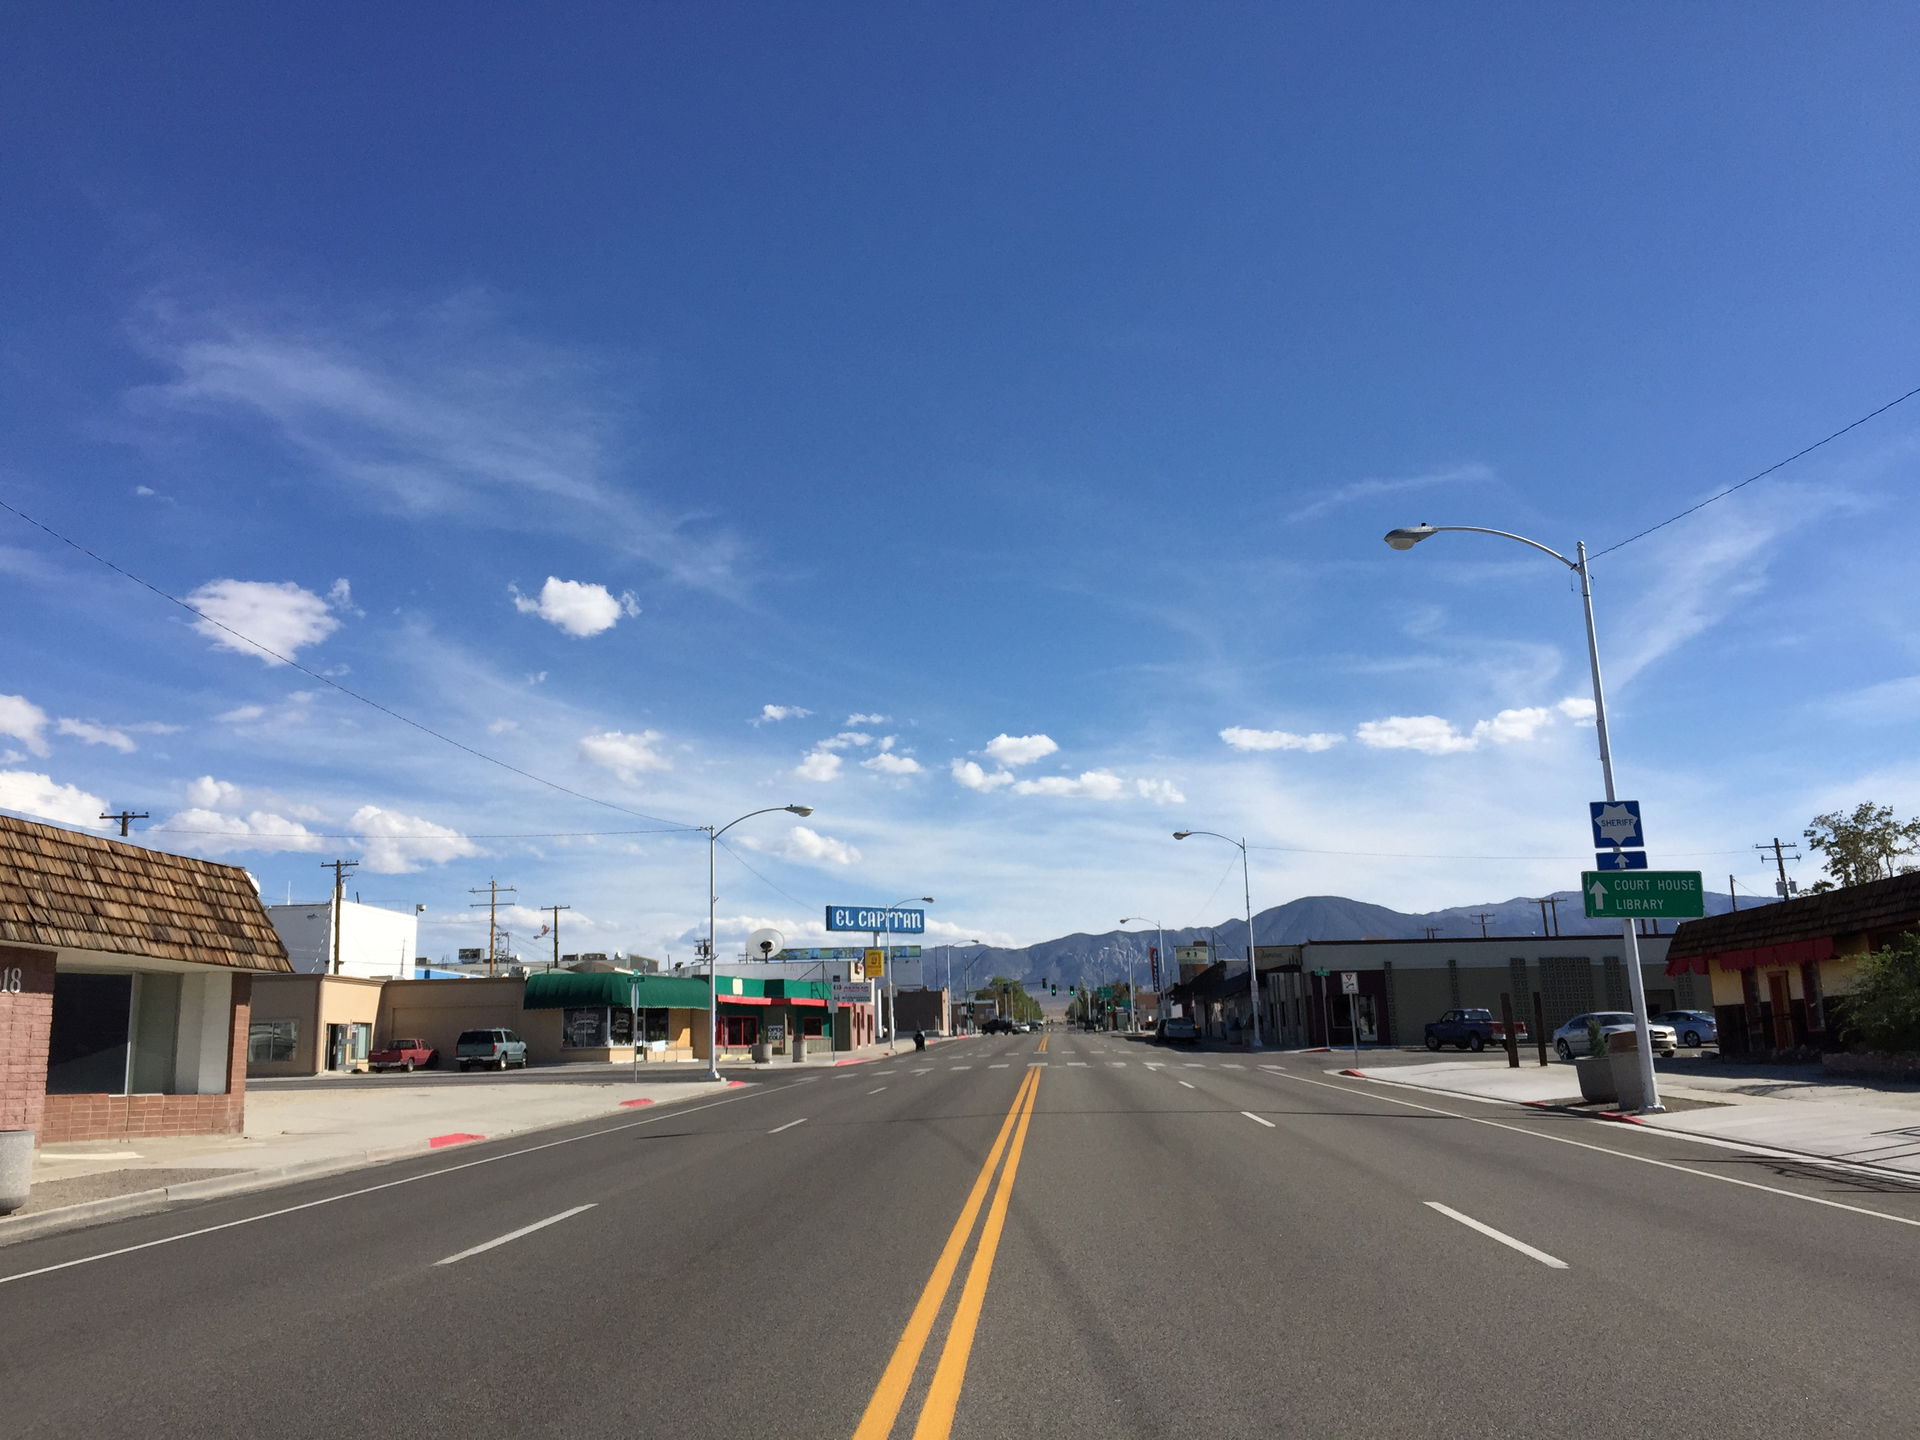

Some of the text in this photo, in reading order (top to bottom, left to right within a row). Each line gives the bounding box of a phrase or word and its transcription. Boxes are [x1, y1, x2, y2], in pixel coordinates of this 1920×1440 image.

[1601, 818, 1634, 827] SHERIFF
[1614, 879, 1696, 891] COURT HOUSE
[1616, 899, 1664, 910] LIBRARY
[836, 909, 922, 929] EL CAPITAN
[0, 967, 22, 993] 18
